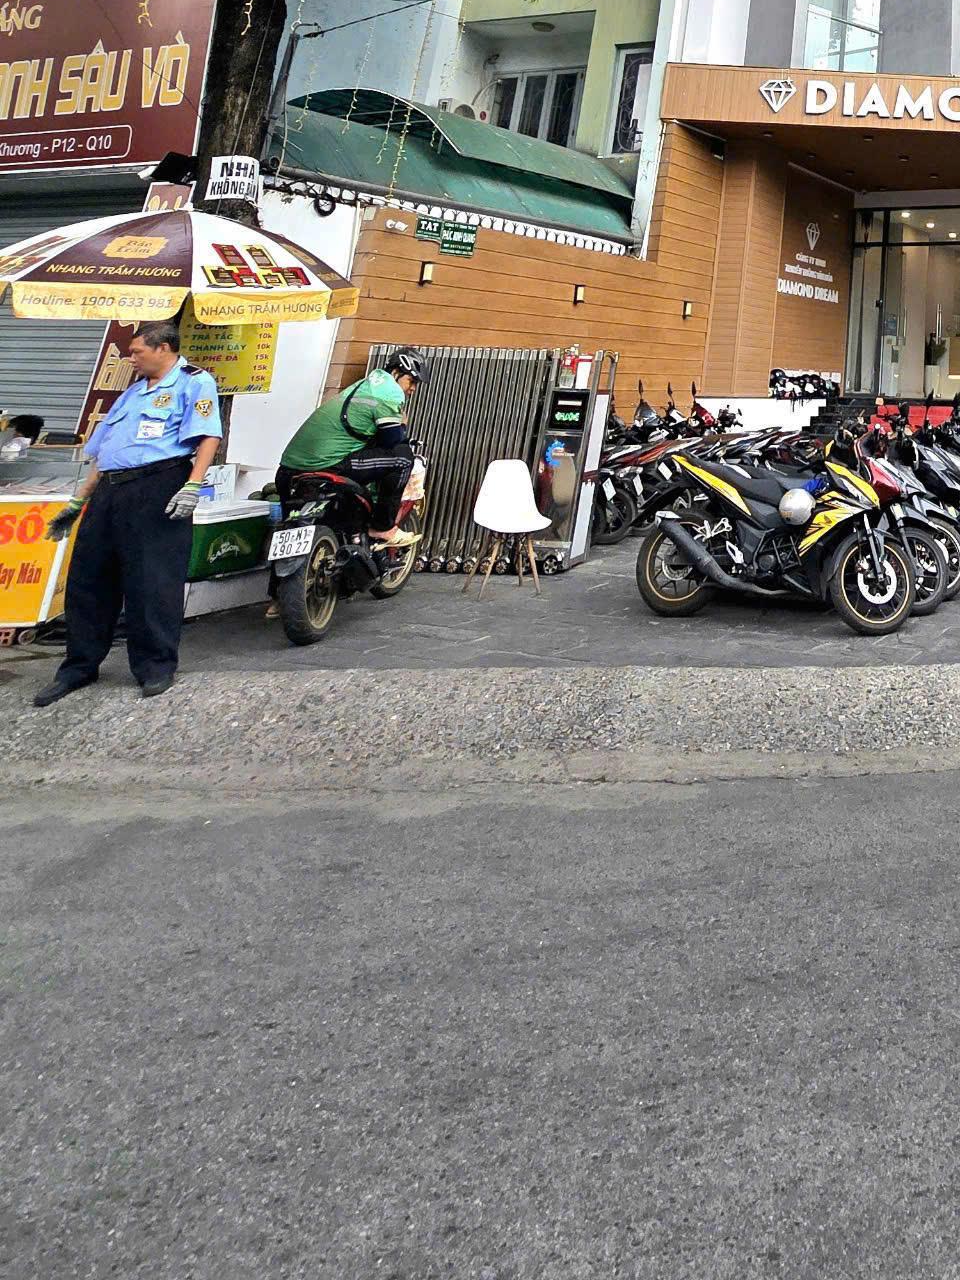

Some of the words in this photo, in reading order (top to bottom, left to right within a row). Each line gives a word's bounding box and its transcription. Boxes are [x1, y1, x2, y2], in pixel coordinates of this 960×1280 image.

[51, 138, 76, 153] P12
[86, 134, 112, 151] Q10
[210, 178, 245, 195] KHÔNG
[420, 220, 440, 231] TAT
[46, 264, 96, 274] NHANG
[134, 267, 182, 277] HƯƠNG
[777, 279, 813, 298] DIAMOND
[20, 294, 76, 306] Hotline:
[80, 296, 116, 307] 1900
[118, 296, 143, 307] 633
[147, 297, 172, 308] 981
[200, 305, 245, 316] NHANG
[283, 303, 322, 313] HƯƠNG
[0, 562, 16, 590] ay
